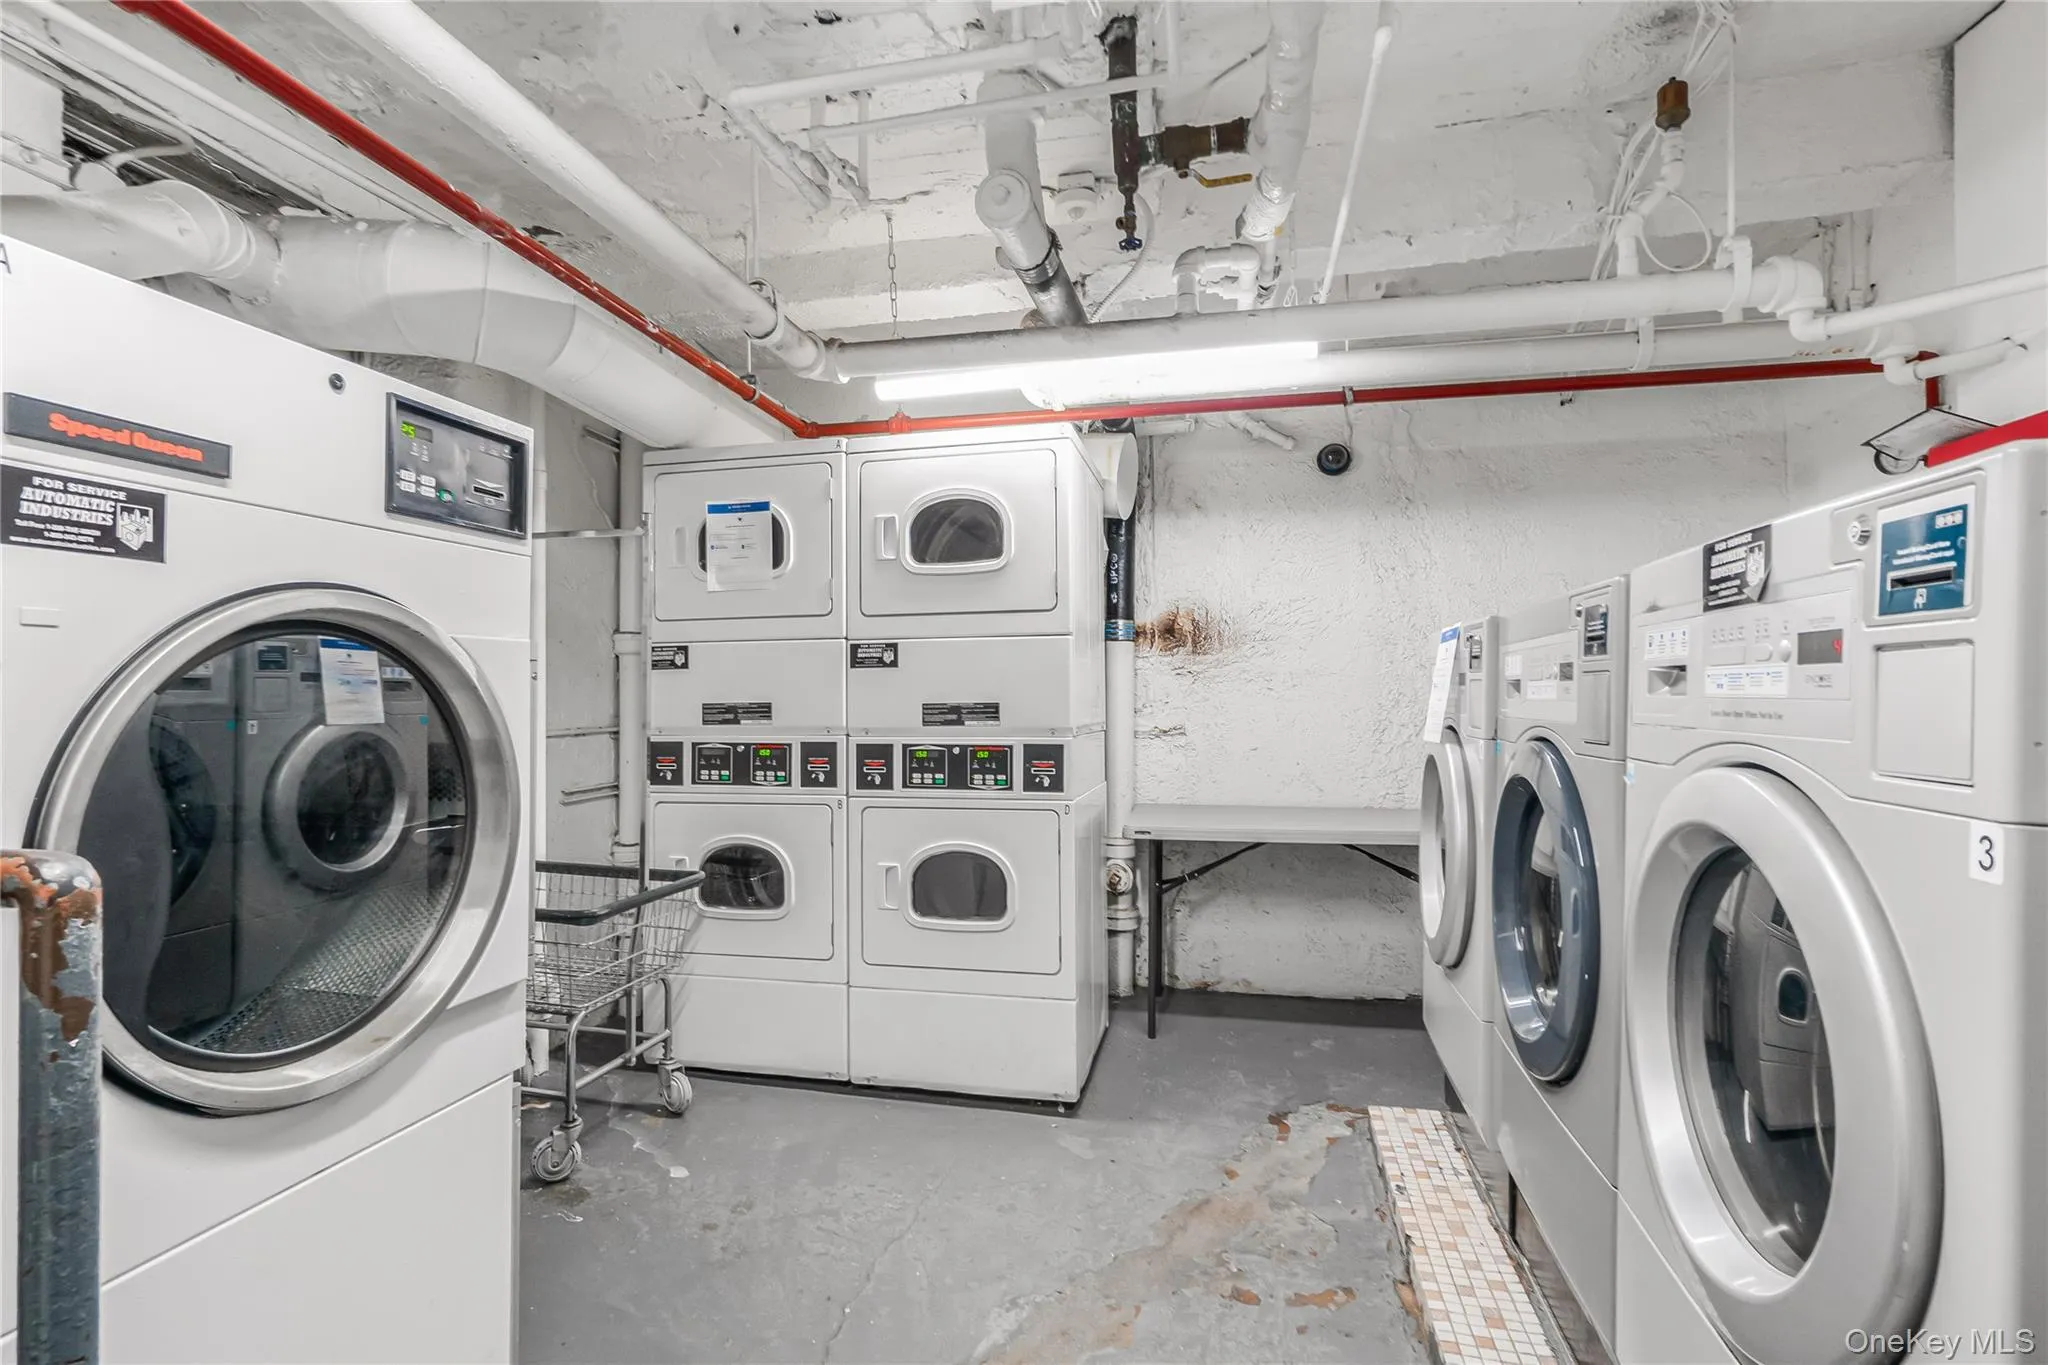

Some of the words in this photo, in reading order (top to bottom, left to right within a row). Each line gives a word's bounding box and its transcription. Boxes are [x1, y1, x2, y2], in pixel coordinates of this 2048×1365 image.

[48, 412, 131, 446] Speed
[132, 431, 204, 463] Queen
[20, 486, 116, 512] AUTOMATIC
[32, 475, 65, 490] FOR
[66, 481, 128, 500] SERVICE
[18, 500, 115, 526] INDUSTRIES
[1978, 835, 1995, 871] 3
